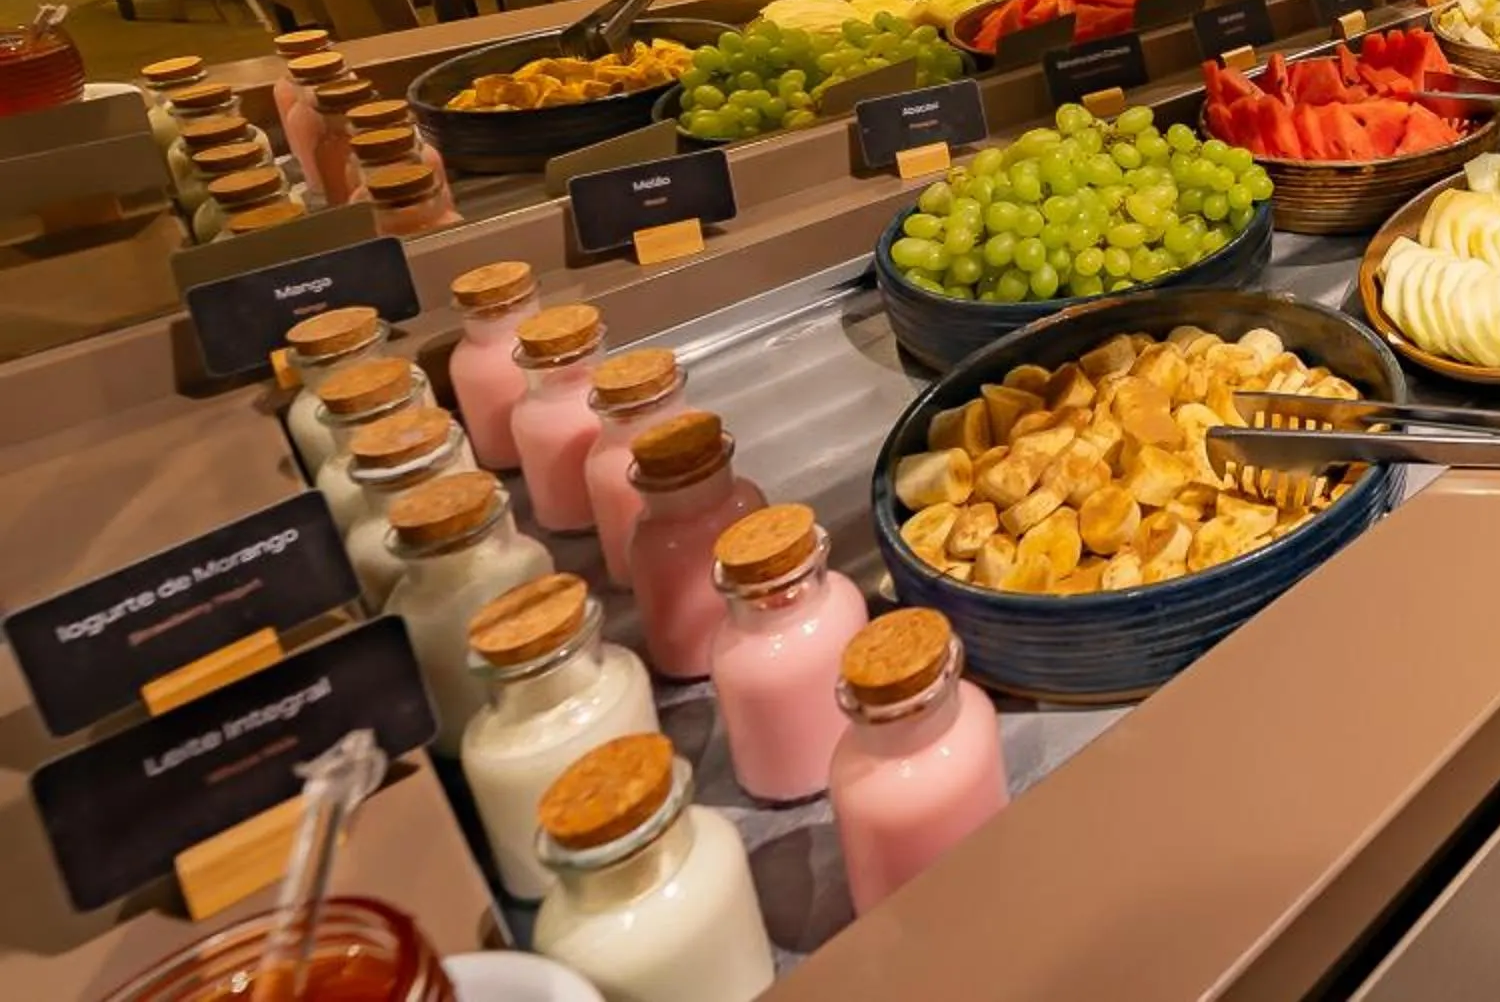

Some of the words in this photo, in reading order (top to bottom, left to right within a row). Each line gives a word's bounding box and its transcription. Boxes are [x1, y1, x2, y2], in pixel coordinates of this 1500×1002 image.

[274, 277, 333, 299] Manga
[55, 591, 156, 643] Iogurte
[157, 574, 193, 600] de
[192, 528, 299, 583] Morango
[143, 730, 222, 778] Leite
